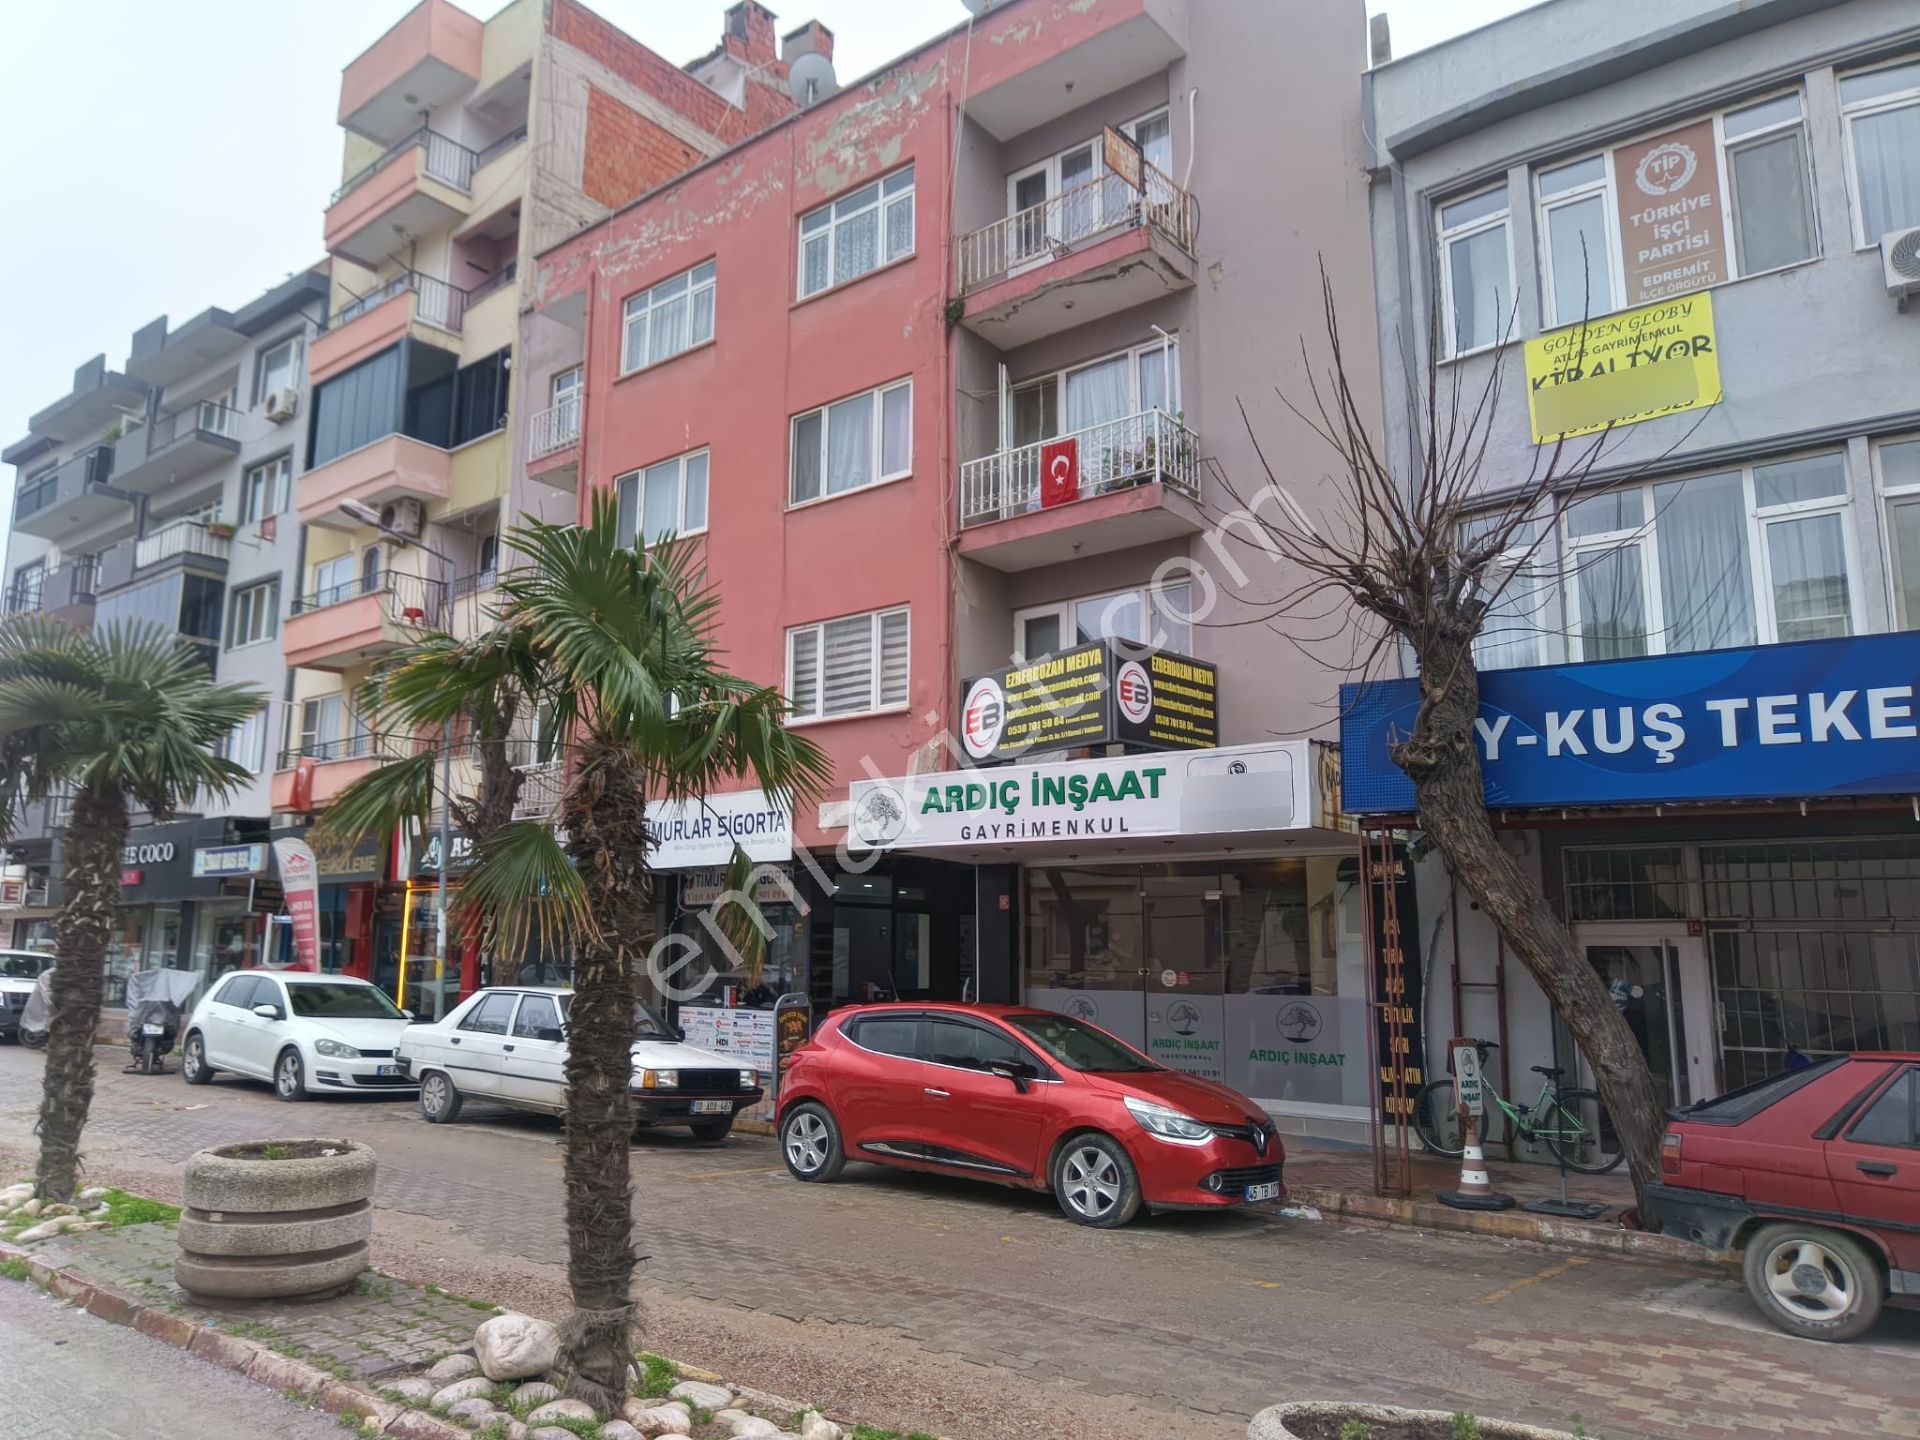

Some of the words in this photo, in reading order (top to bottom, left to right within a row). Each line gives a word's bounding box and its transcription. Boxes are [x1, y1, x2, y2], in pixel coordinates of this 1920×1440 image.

[1651, 155, 1681, 173] TİP
[1630, 193, 1712, 227] TÜRKİYE
[1653, 215, 1691, 240] İŞÇİ
[1638, 230, 1710, 263] PARTİSİ
[1640, 284, 1665, 300] İLÇE
[1667, 272, 1717, 292] ÖRGÜTÜ
[1643, 260, 1711, 287] EDREMİT
[1543, 320, 1624, 354] GOLDEN
[1628, 301, 1693, 331] GLOBY
[1553, 348, 1589, 365] ATLAS
[1593, 323, 1684, 355] GAYRİMENKUL
[1066, 648, 1103, 672] MEDYA
[1120, 680, 1149, 704] EB
[1475, 700, 1687, 764] Y-KUŞ
[921, 780, 1020, 815] ARDIÇ
[1031, 767, 1166, 811] İNŞAAT
[717, 809, 786, 838] SİGORTA
[960, 816, 1130, 841] GAYRİMENKUL
[139, 842, 174, 863] COCO
[1152, 1037, 1181, 1051] ARDIÇ
[1184, 1038, 1220, 1052] İNŞAAT
[1248, 1049, 1290, 1066] ARDIÇ
[1294, 1049, 1346, 1068] İNŞAAT
